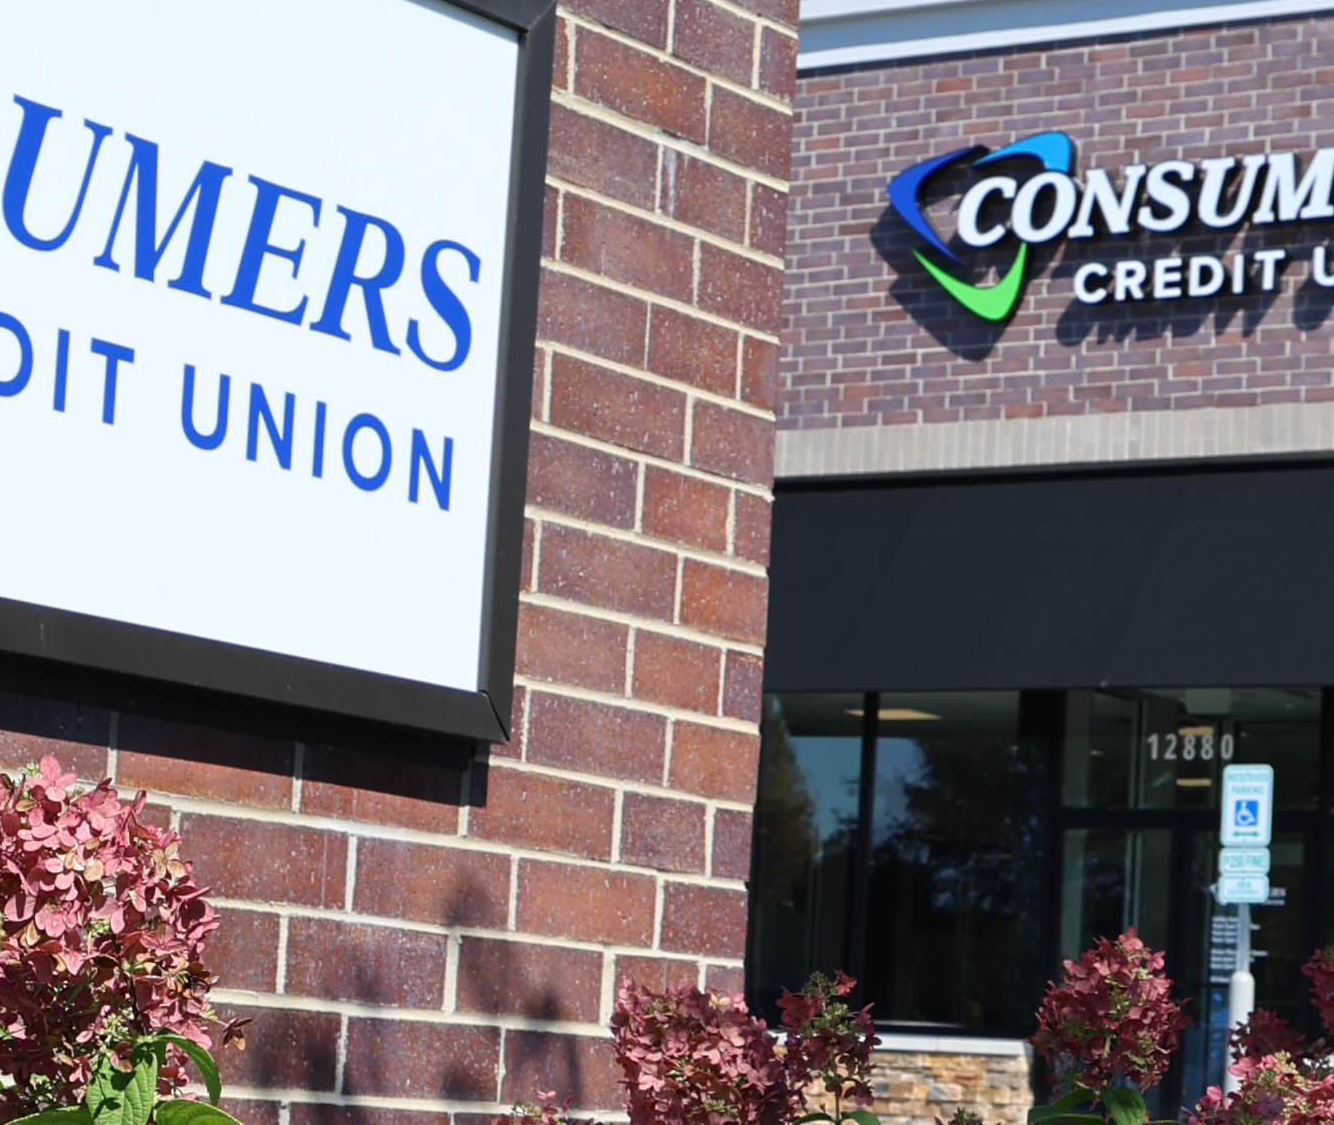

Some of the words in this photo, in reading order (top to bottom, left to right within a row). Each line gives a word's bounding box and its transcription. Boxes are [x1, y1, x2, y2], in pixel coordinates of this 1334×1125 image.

[1072, 248, 1286, 304] CREDIT
[179, 362, 455, 513] UNION
[1147, 733, 1235, 761] 12880
